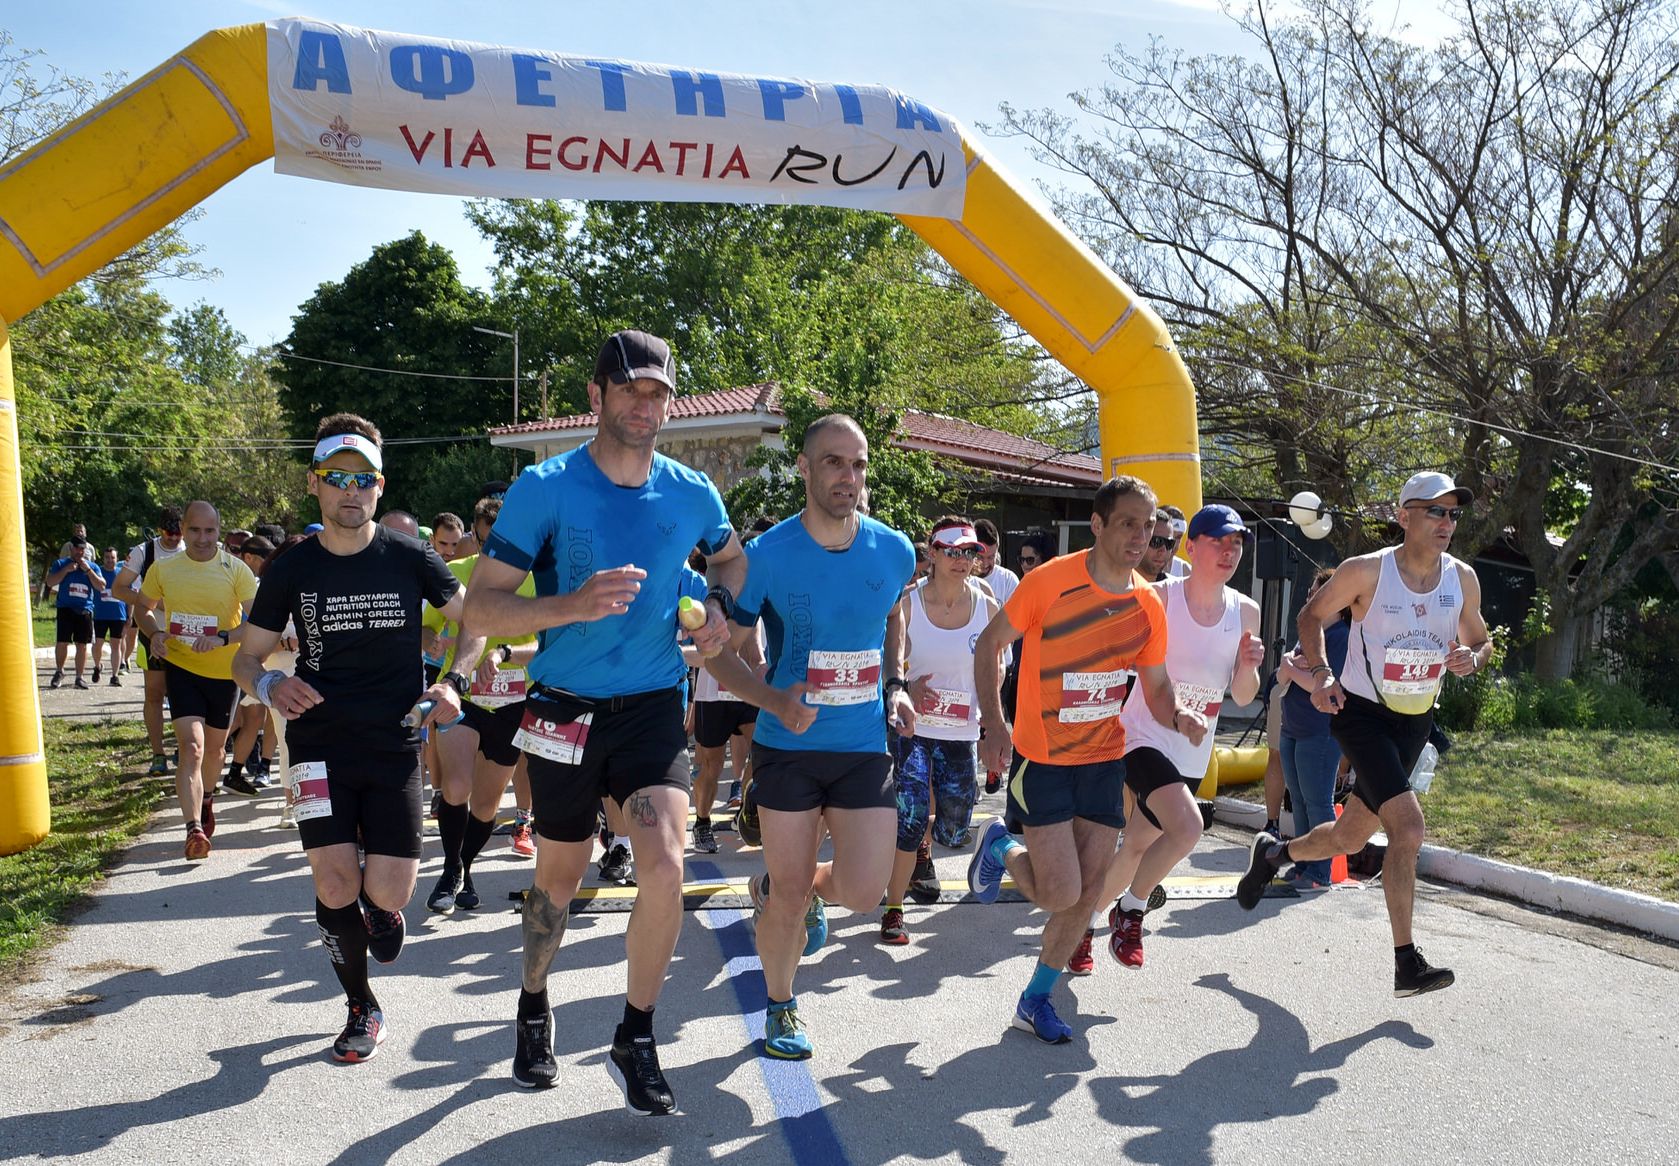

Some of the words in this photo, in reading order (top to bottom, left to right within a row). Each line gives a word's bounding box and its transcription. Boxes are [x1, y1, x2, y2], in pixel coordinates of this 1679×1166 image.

[292, 29, 942, 133] ΑΦΕΤΗΡΙΑ
[399, 125, 496, 168] VIA
[526, 133, 751, 179] EGNATIA
[769, 144, 944, 190] RUN
[326, 596, 347, 604] ΧΑΡΑ
[349, 593, 400, 602] ΣΚΟΥΛΑΡΙΚΗ
[326, 601, 371, 612] NUTRITION
[372, 600, 401, 608] COACH
[181, 624, 204, 635] 255
[322, 620, 363, 632] adidas
[368, 619, 406, 629] TERREX
[834, 669, 859, 683] 33
[1092, 672, 1120, 681] EGNATIA
[1402, 665, 1430, 677] 149
[491, 682, 509, 693] 60
[1087, 688, 1107, 703] 74
[934, 702, 951, 716] 27
